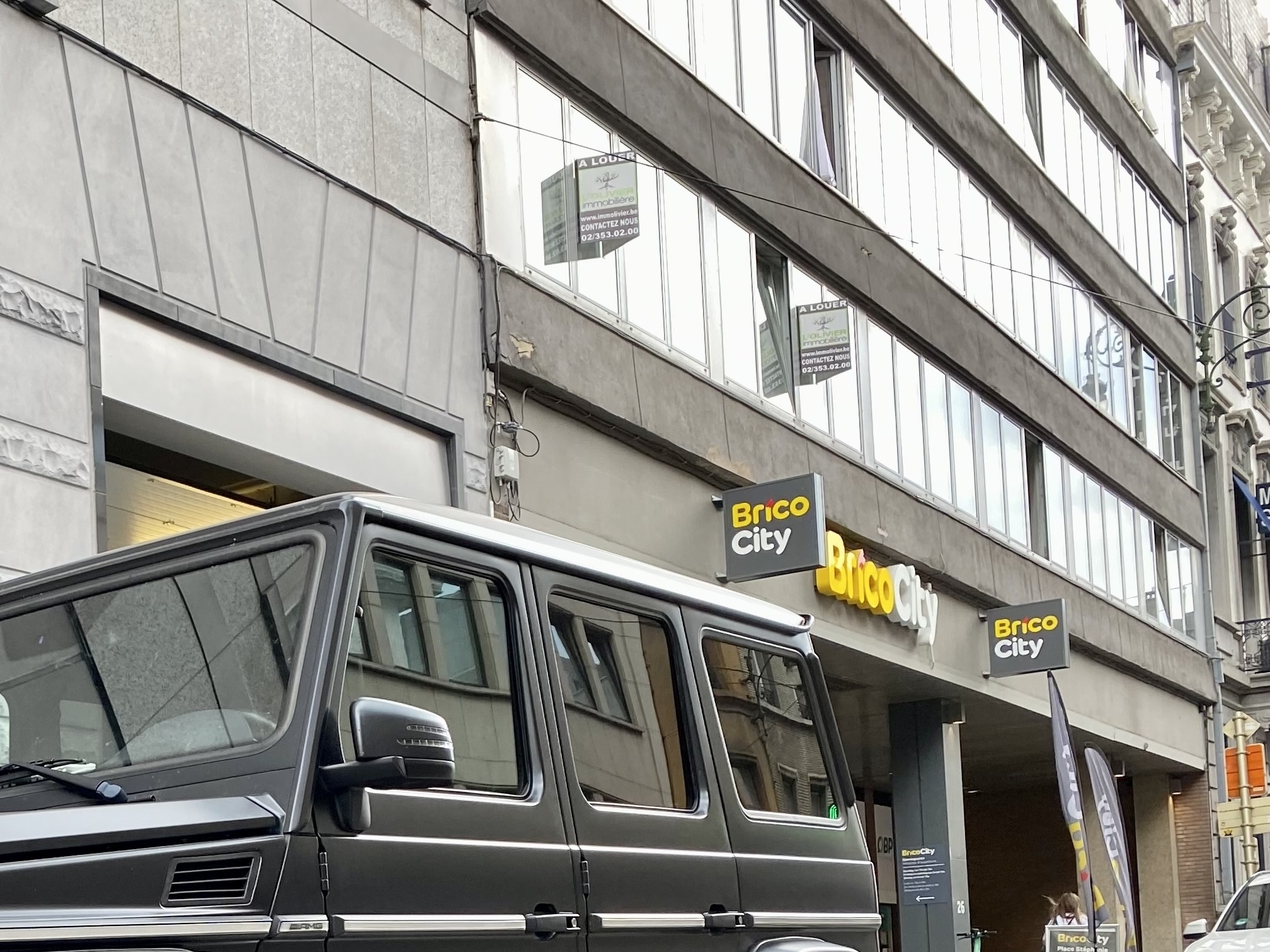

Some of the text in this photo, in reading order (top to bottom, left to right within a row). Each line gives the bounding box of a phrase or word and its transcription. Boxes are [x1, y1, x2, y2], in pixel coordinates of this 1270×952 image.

[578, 151, 636, 168] A LOUER
[580, 217, 639, 232] CONTACTEZ NOUS
[581, 227, 639, 242] 02/353.02.00
[810, 300, 847, 311] LOUER
[801, 353, 850, 366] CONTACTEZ NOUS
[801, 361, 851, 373] 02/353.02.00
[731, 495, 810, 528] Brico
[731, 526, 792, 555] City
[994, 615, 1059, 638] Brico
[994, 636, 1044, 659] City
[901, 847, 936, 857] BricoCity
[956, 900, 966, 914] 26
